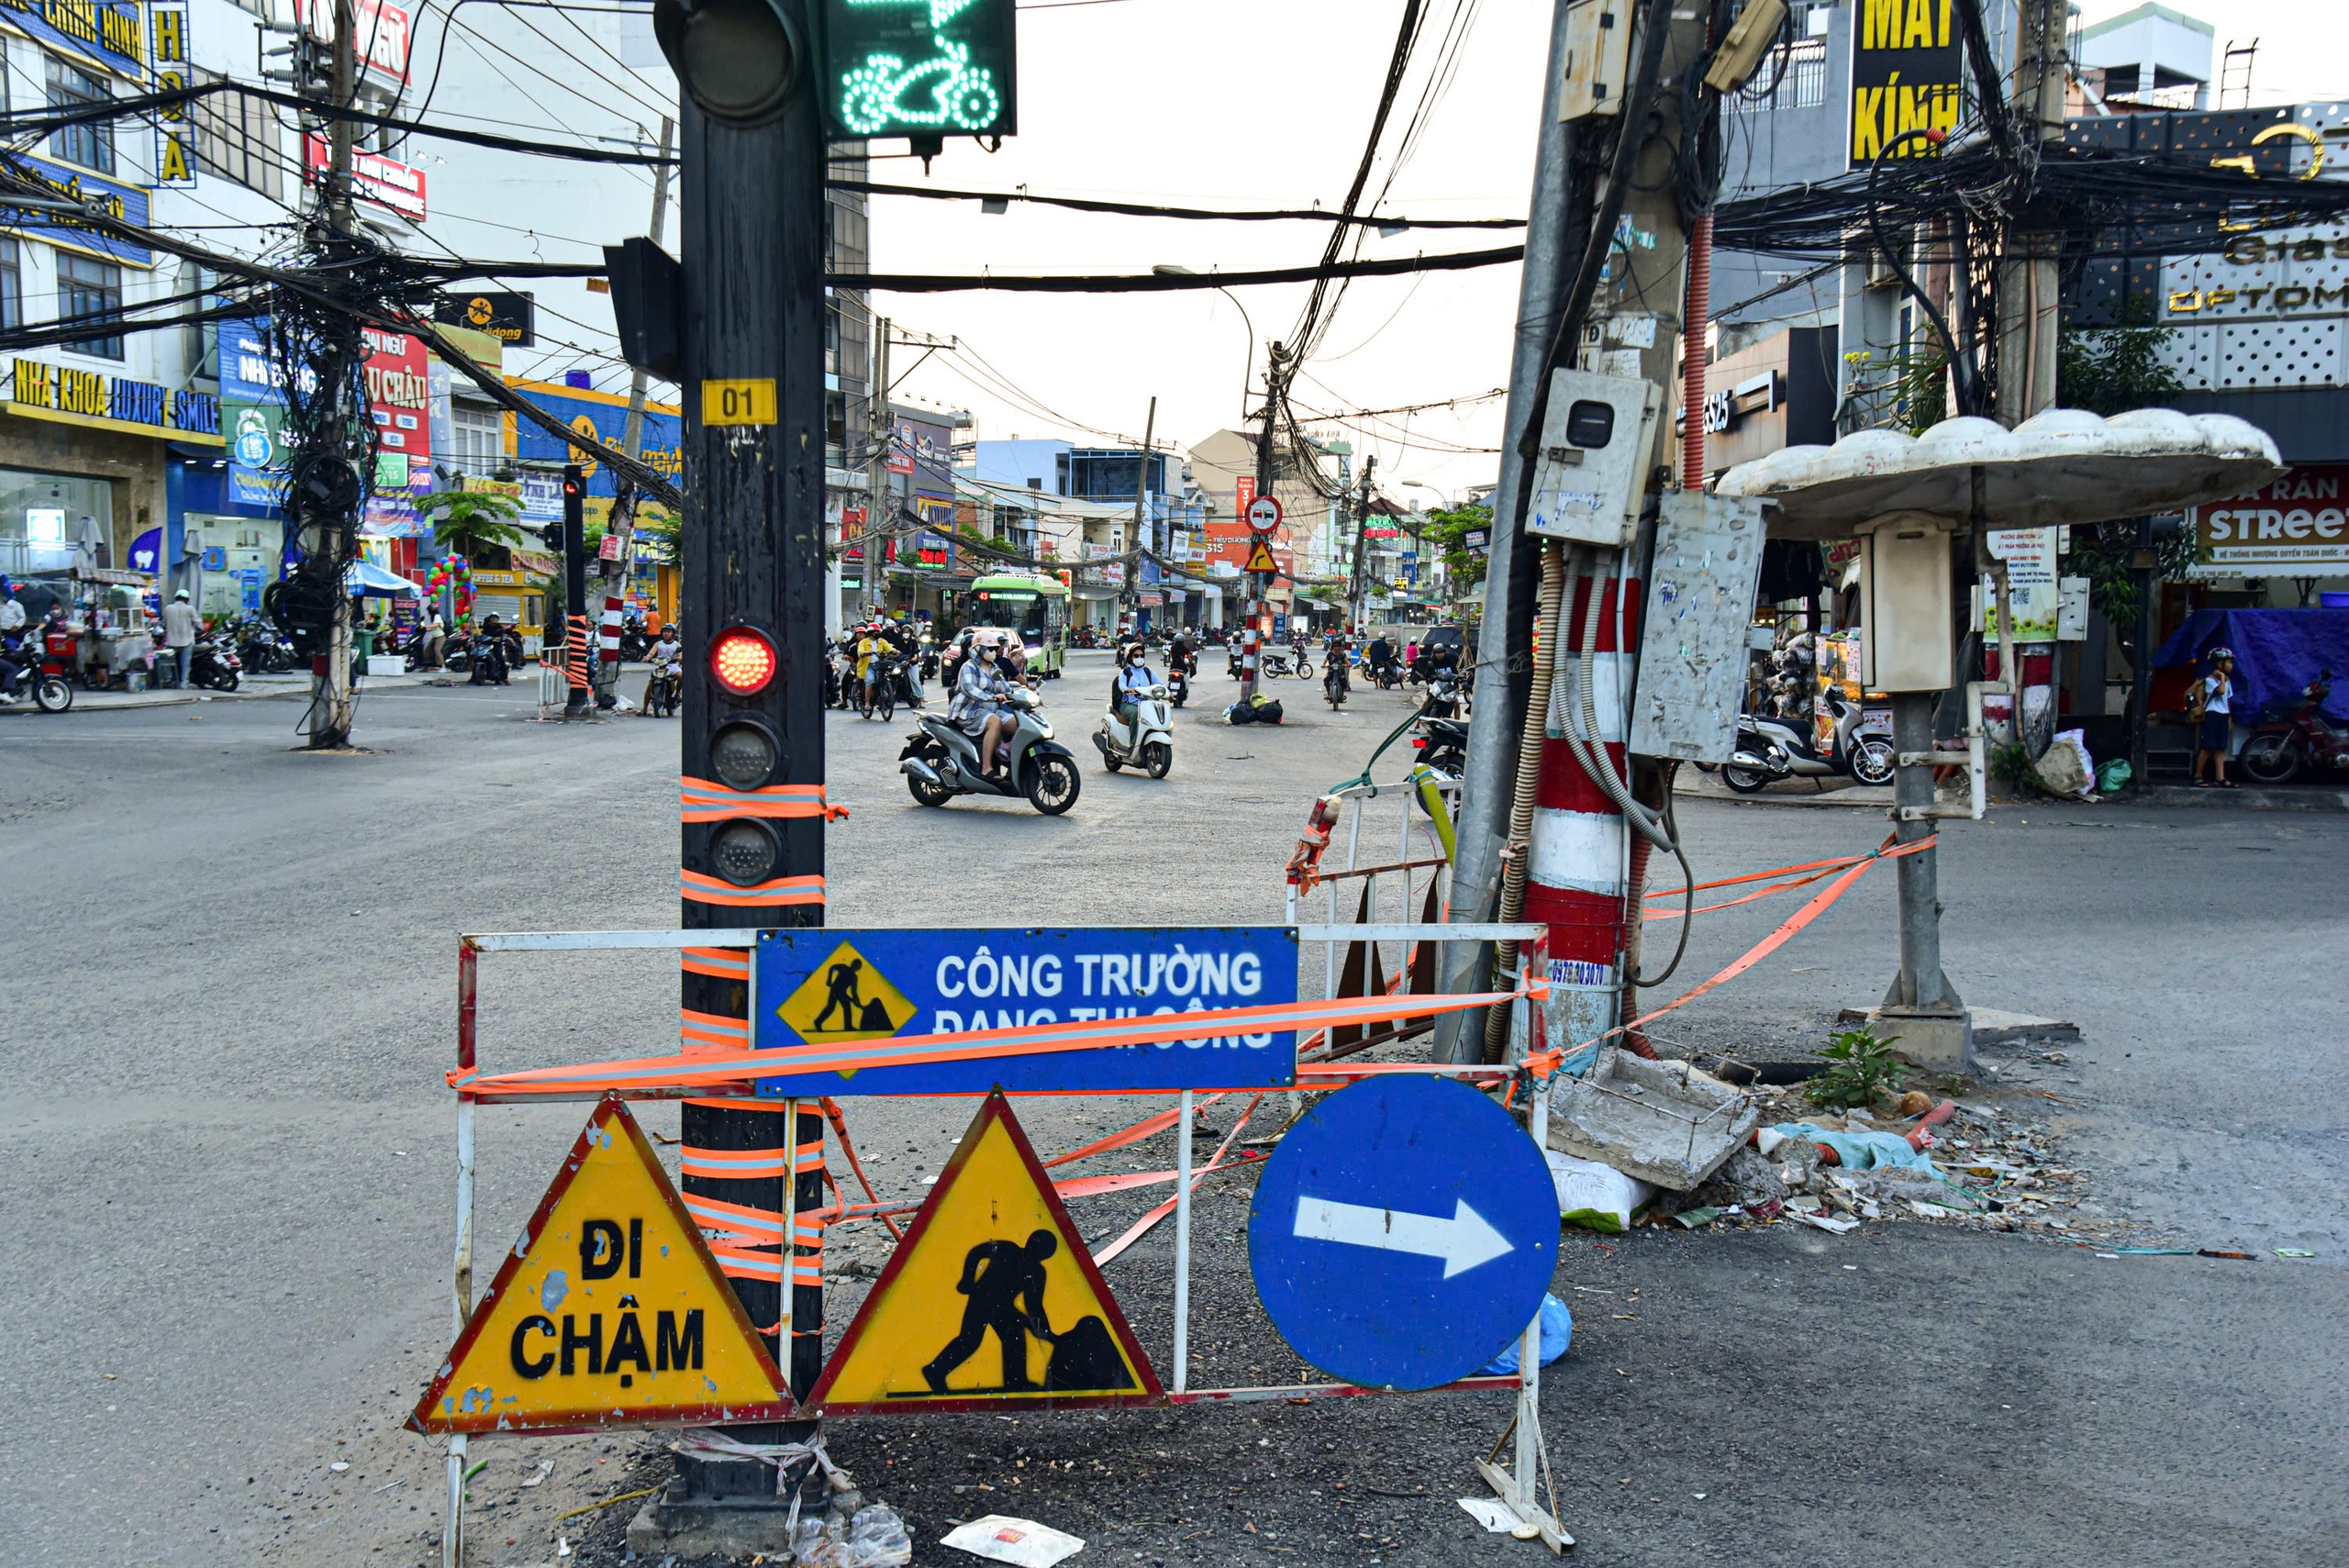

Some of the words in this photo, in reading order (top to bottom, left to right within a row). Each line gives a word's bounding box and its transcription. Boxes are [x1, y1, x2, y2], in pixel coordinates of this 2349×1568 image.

[1853, 71, 1959, 160] KÍNH
[14, 358, 52, 408] NHA
[59, 367, 106, 417] KHOA
[112, 376, 171, 427] LUXURY
[175, 389, 219, 435] SMILE
[722, 387, 752, 417] 01
[2272, 472, 2339, 501] RÁN
[936, 945, 1063, 998] CÔNG
[1074, 943, 1263, 997] TRƯỜNG
[579, 1218, 643, 1281] ĐI
[510, 1294, 705, 1388] CHẬM
